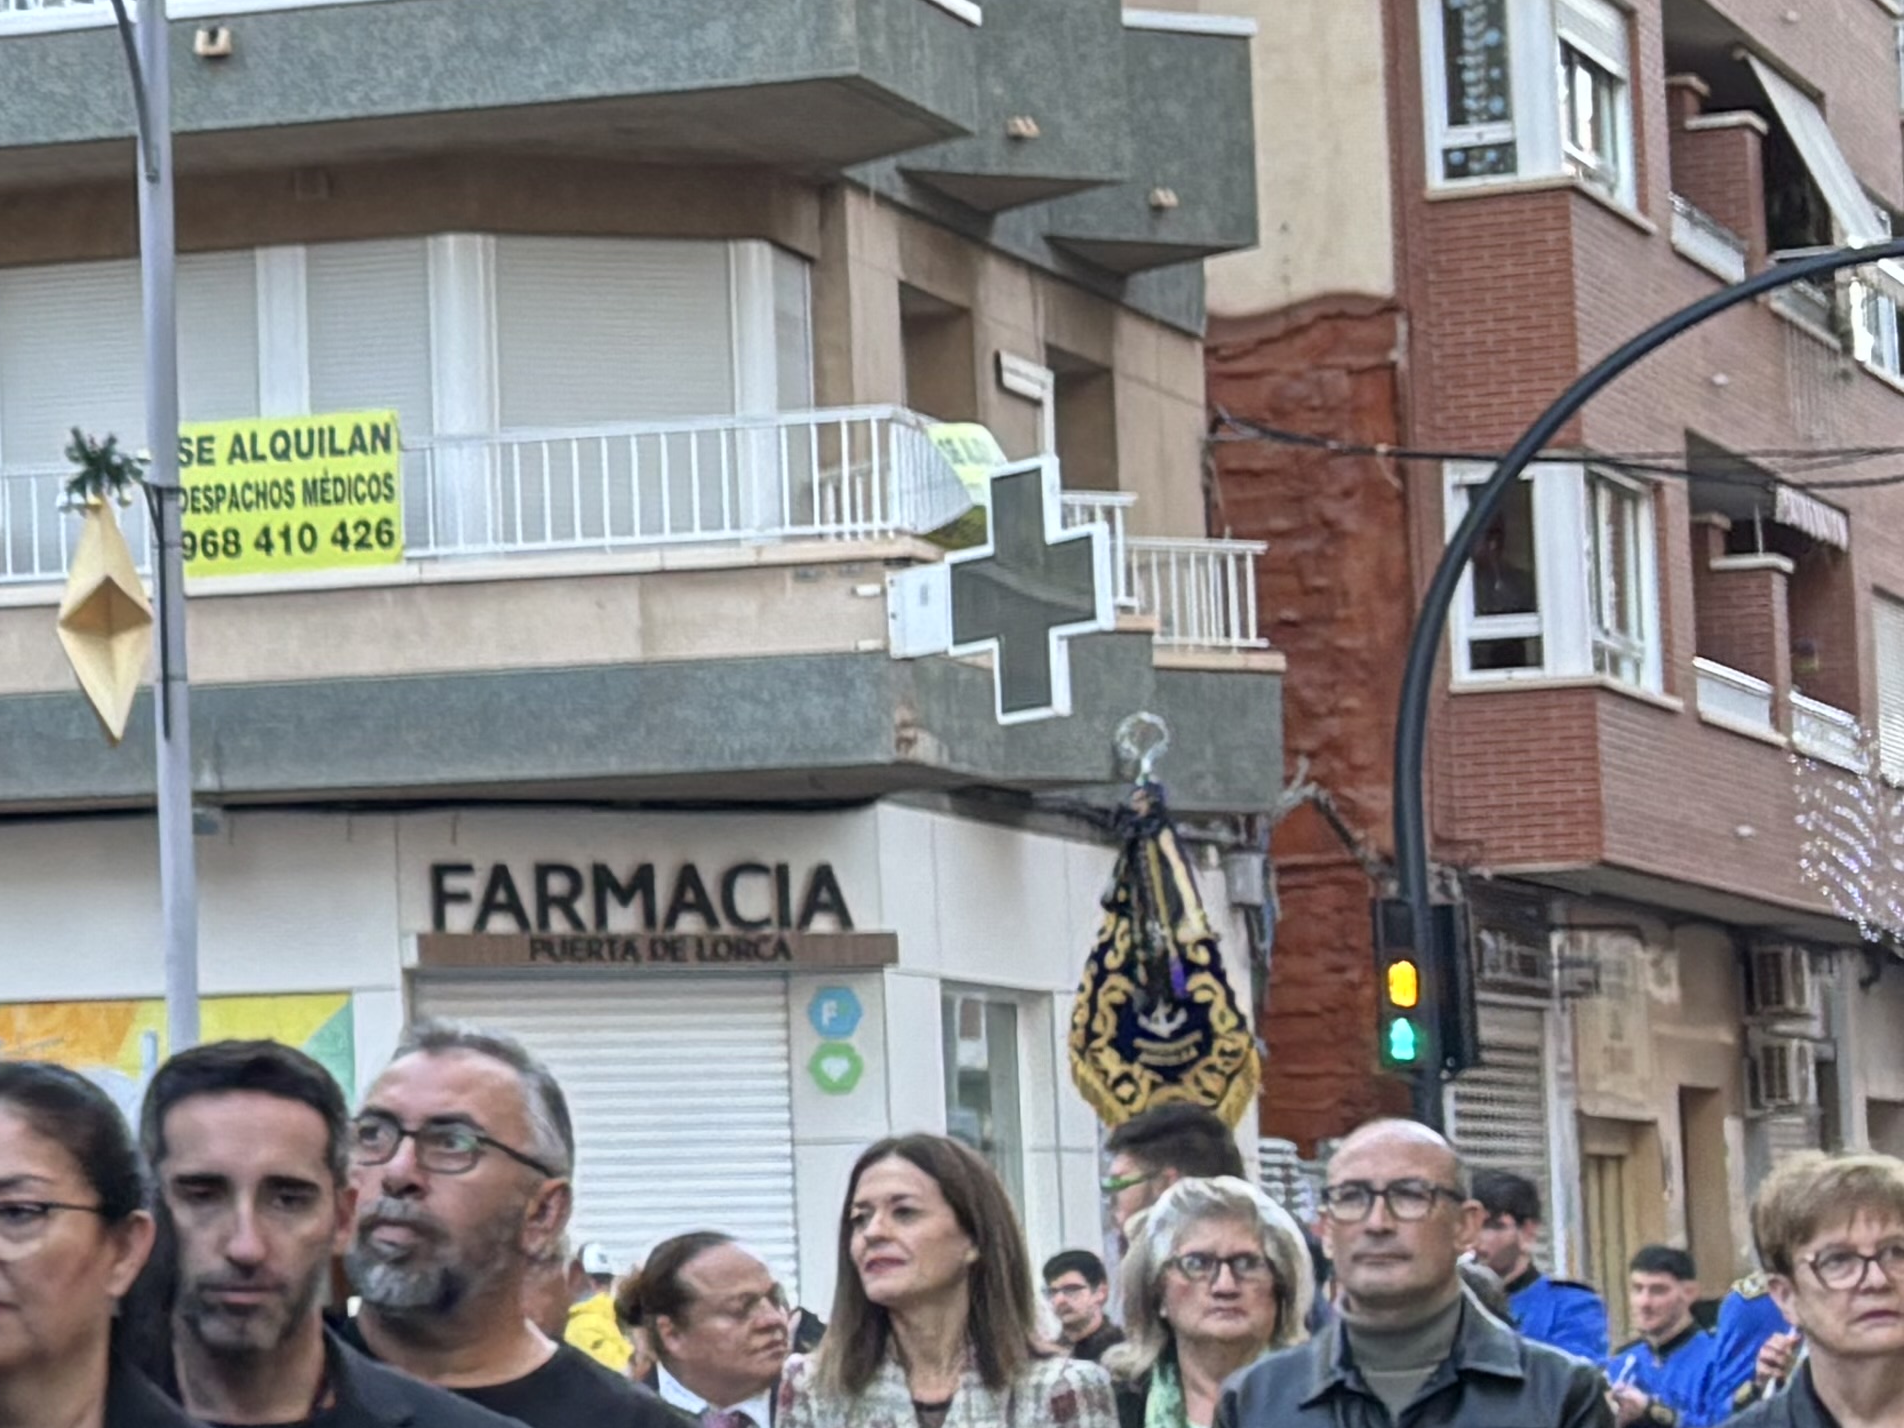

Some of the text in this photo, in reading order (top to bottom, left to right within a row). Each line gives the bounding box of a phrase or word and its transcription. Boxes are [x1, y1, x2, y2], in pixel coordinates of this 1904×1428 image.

[178, 422, 392, 467] SE ALQUILAN
[179, 467, 396, 515] DESPACHOS MÉDICOS
[182, 517, 396, 561] 968 410 426
[429, 862, 856, 933] FARMACIA
[529, 937, 794, 963] PUERTA DE LORCA
